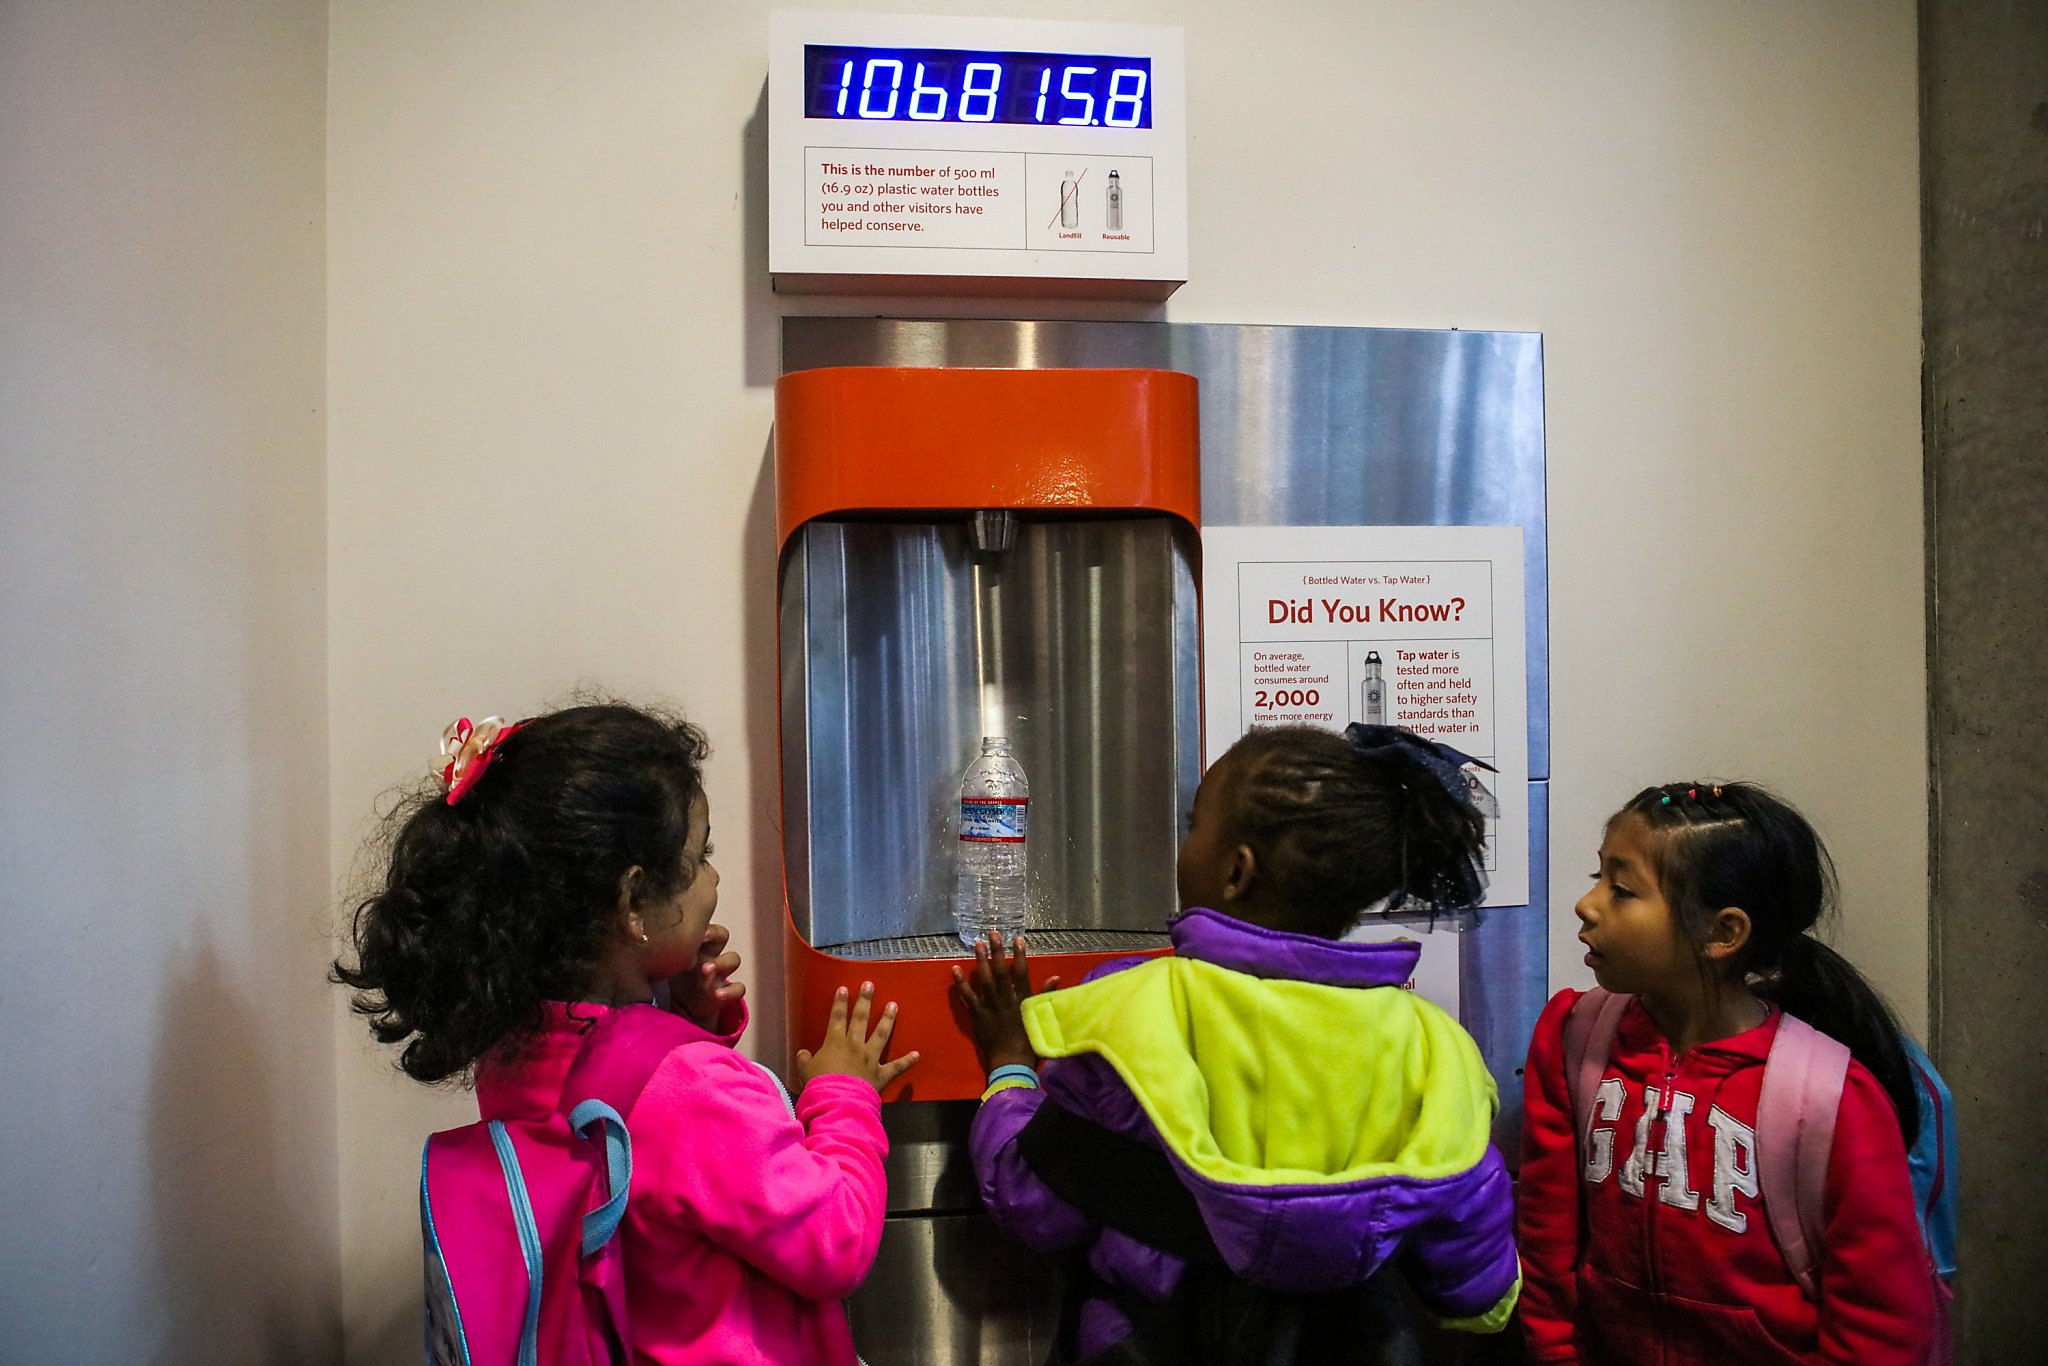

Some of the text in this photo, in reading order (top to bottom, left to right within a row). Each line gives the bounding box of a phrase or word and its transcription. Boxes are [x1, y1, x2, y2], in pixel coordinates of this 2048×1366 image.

[821, 163, 995, 181] This is the number of 500 ml
[822, 181, 1000, 197] (16.9 oz) plastic water bottles
[822, 200, 984, 215] you and other visitors have
[822, 218, 924, 232] helped conserve.
[1103, 233, 1131, 241] Reusable
[1340, 576, 1367, 585] Water
[1368, 577, 1381, 585] vs.
[1383, 575, 1398, 586] Tap
[1269, 597, 1465, 623] Did You Know?
[1254, 651, 1305, 662] On average,
[1396, 649, 1460, 663] Tap water is
[1254, 663, 1311, 673] bottled water
[1397, 663, 1460, 676] tested more
[1255, 674, 1329, 685] consumes around
[1397, 677, 1472, 691] often and held
[1255, 690, 1319, 710] 2,000
[1397, 693, 1478, 707] to higher safety
[1255, 712, 1334, 722] times more energy
[1398, 707, 1475, 720] standards than
[1438, 723, 1467, 734] water
[1470, 722, 1479, 733] in
[1585, 1078, 1760, 1233] GAP
